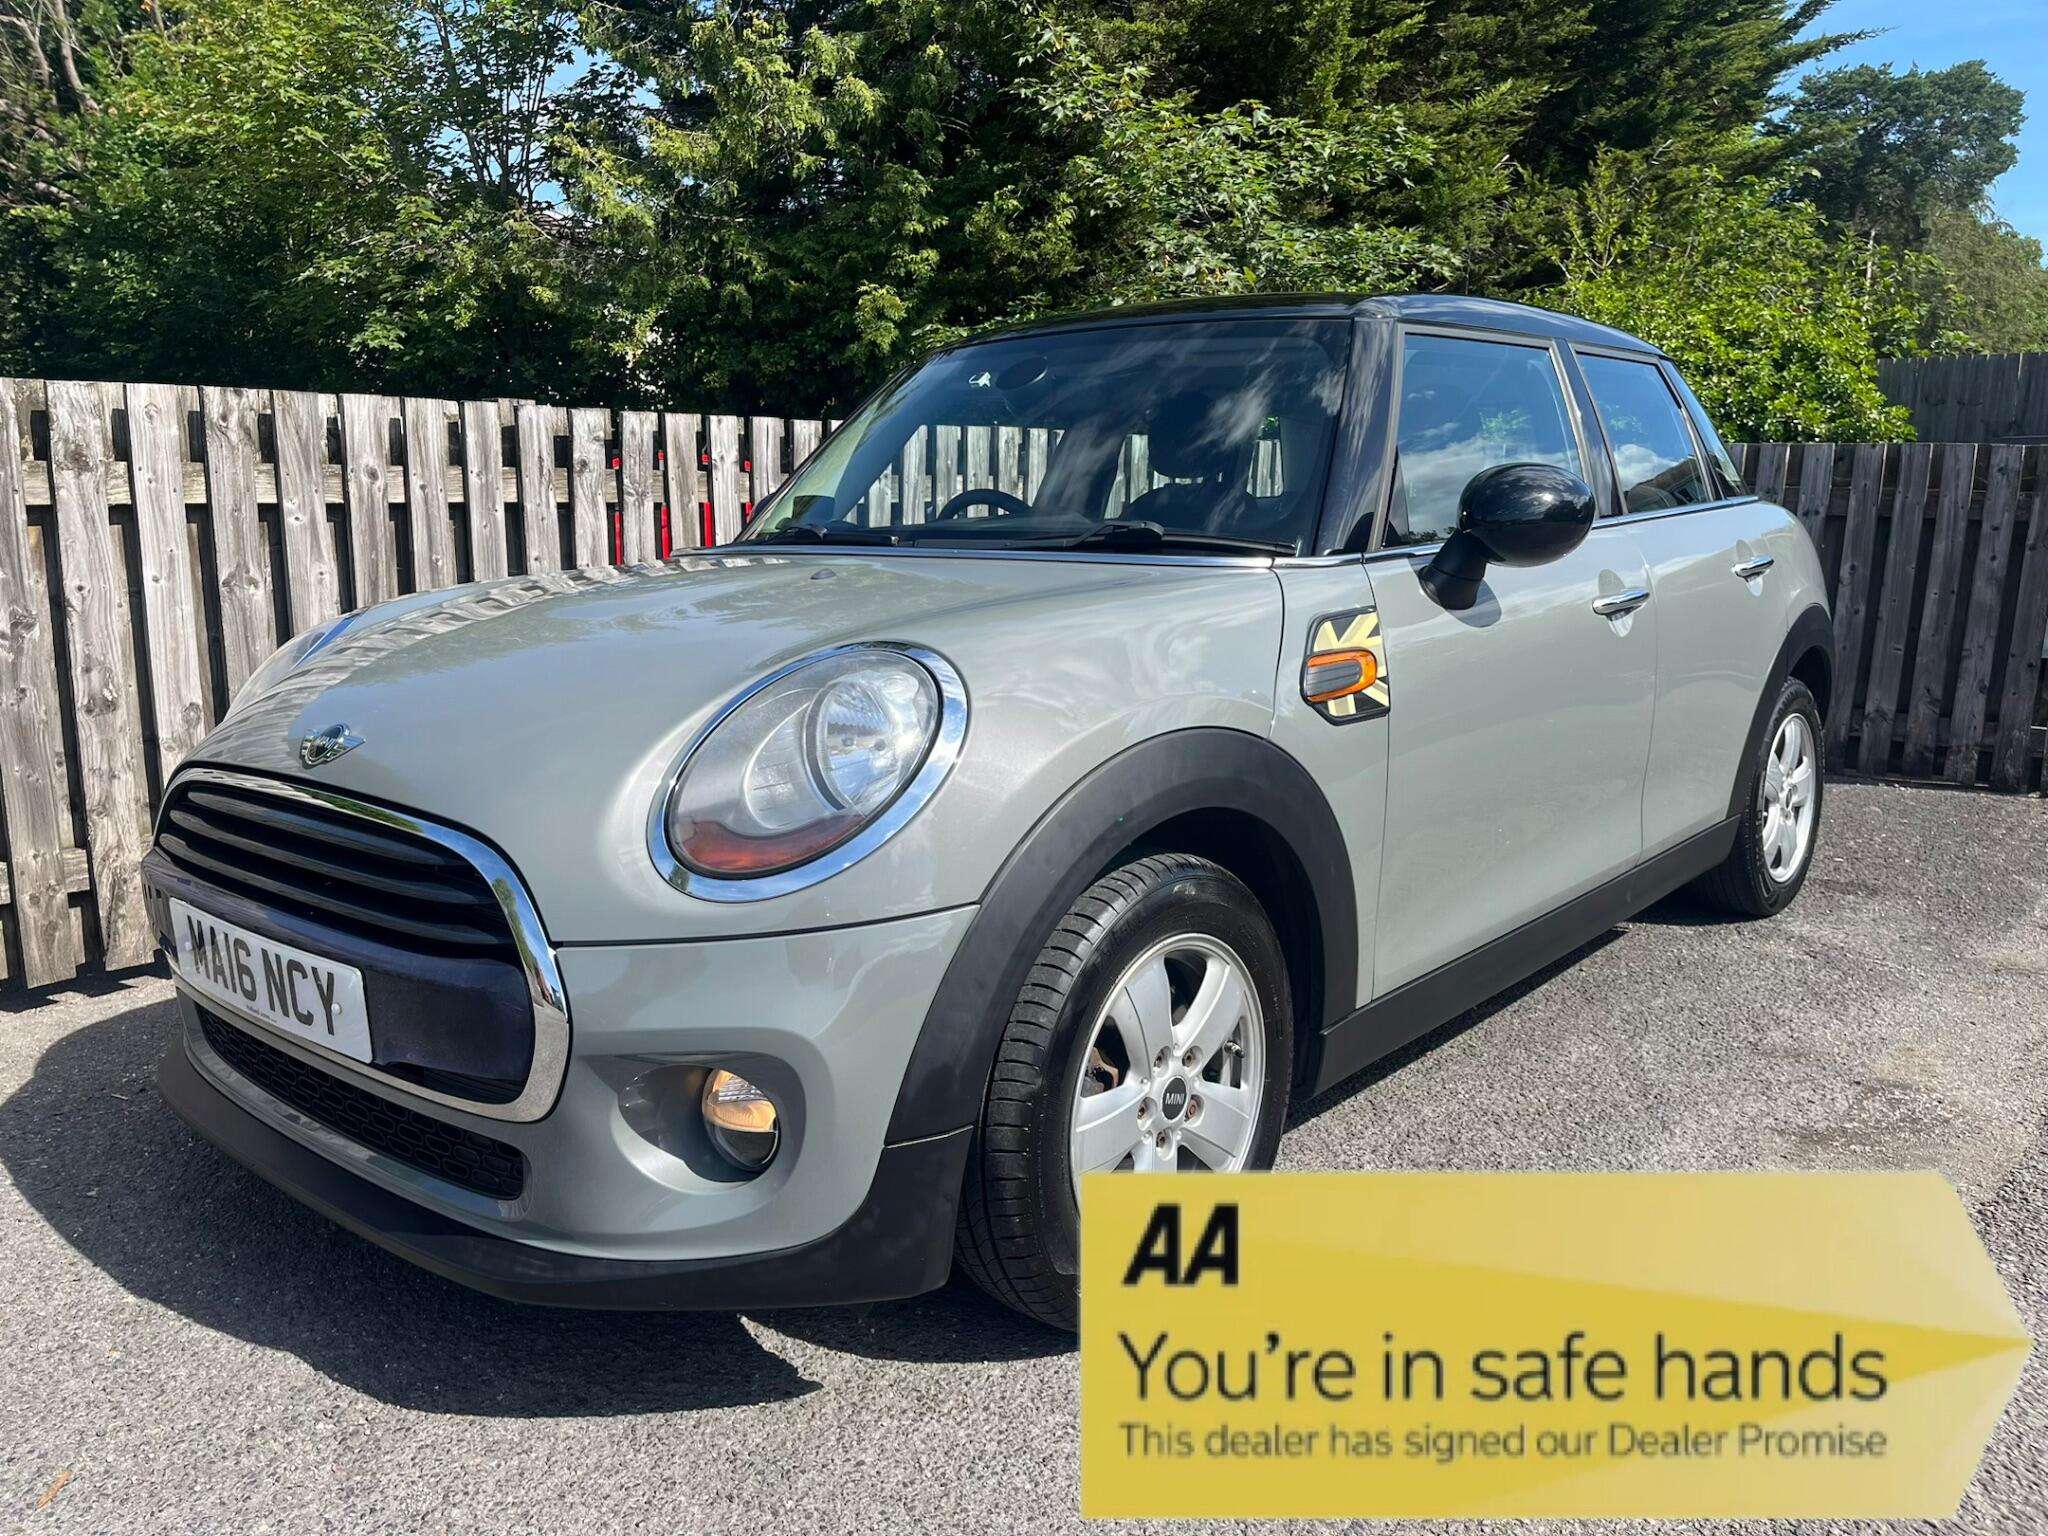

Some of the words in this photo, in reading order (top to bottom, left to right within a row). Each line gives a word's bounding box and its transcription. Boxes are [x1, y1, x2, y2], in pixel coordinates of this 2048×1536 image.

[187, 915, 257, 1002] MA16
[261, 947, 335, 1036] NCY
[1165, 1092, 1185, 1105] MINI
